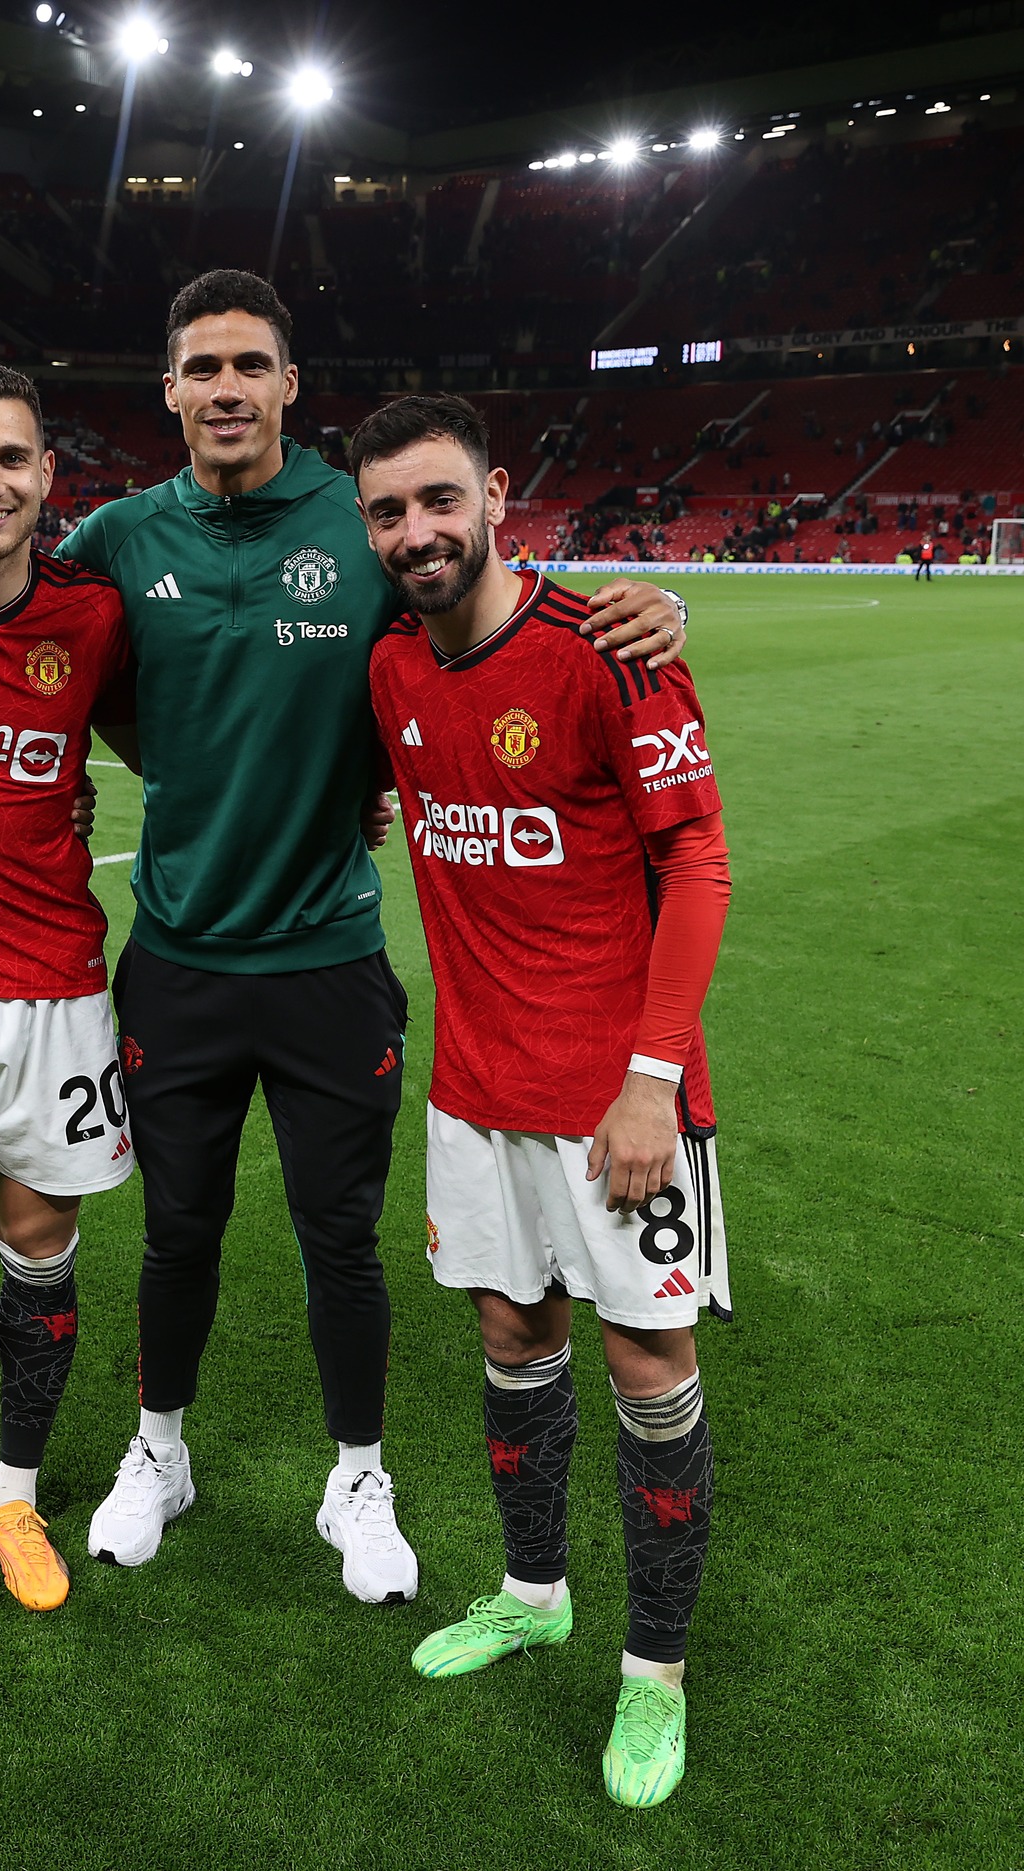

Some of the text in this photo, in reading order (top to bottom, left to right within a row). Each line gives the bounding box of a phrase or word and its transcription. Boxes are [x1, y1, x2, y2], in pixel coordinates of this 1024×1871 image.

[852, 327, 885, 342] AND
[986, 319, 1018, 333] THE
[392, 357, 415, 368] ALL
[287, 552, 332, 570] MANCHESTER
[294, 589, 326, 599] UNITED
[296, 622, 348, 639] Tezos
[29, 645, 68, 663] MANCHESTER
[36, 681, 63, 691] UNITED
[495, 712, 536, 735] MANCHESTER
[501, 754, 529, 765] UNITED
[418, 790, 499, 834] Team
[59, 1059, 126, 1145] 20
[636, 1185, 695, 1265] 8
